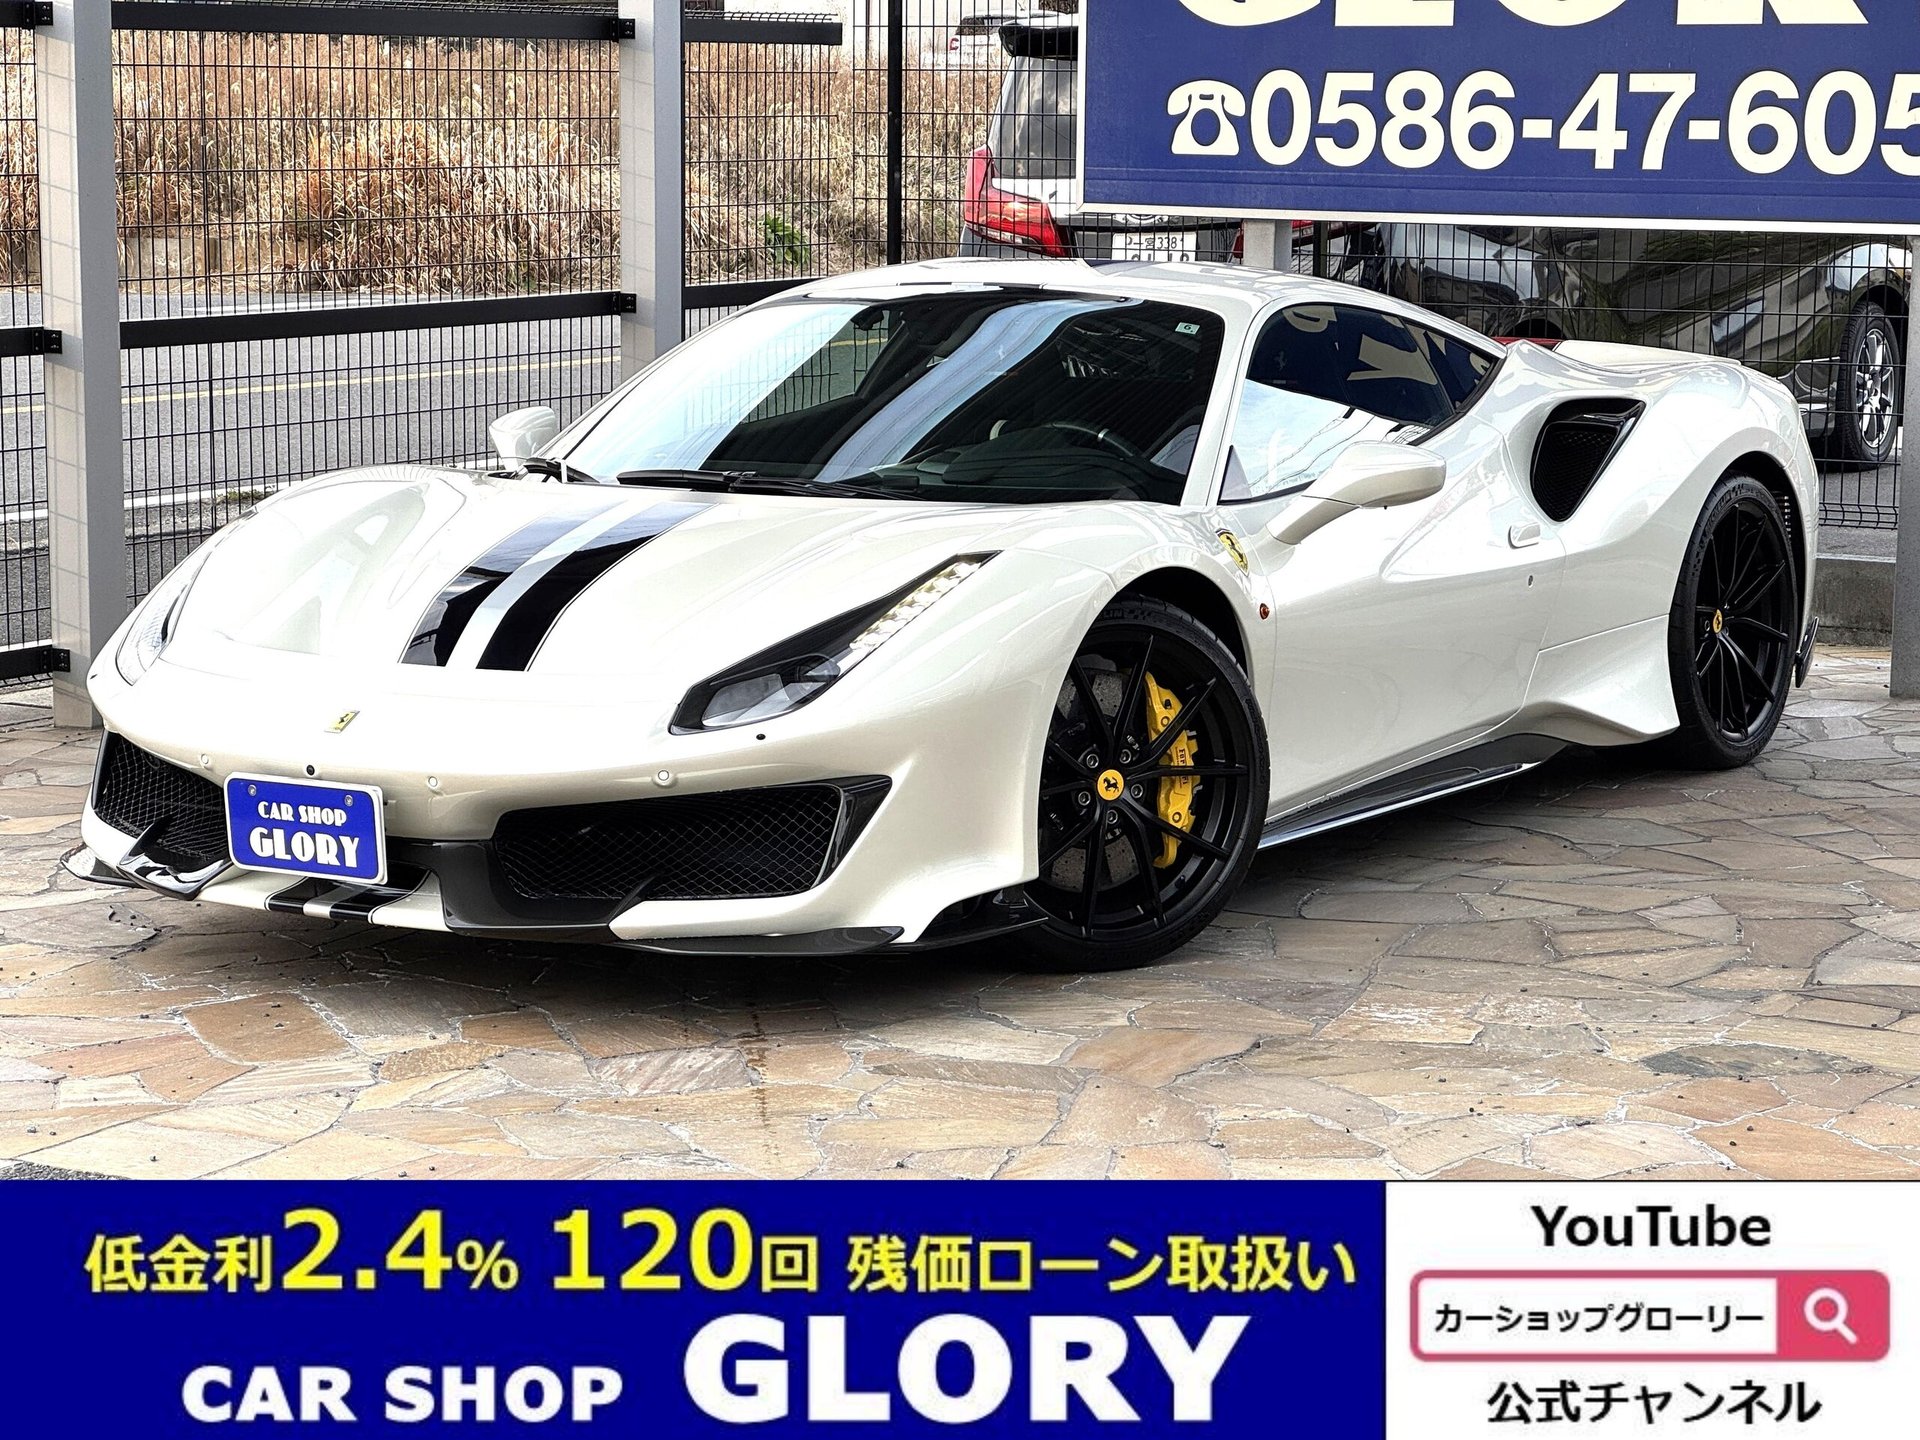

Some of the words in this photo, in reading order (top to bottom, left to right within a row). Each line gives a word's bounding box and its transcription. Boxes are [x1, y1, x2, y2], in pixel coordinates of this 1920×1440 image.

[1250, 69, 1920, 177] 0586-47-605
[257, 801, 295, 822] CAR
[298, 804, 347, 827] SHOP
[250, 827, 360, 868] GLORY
